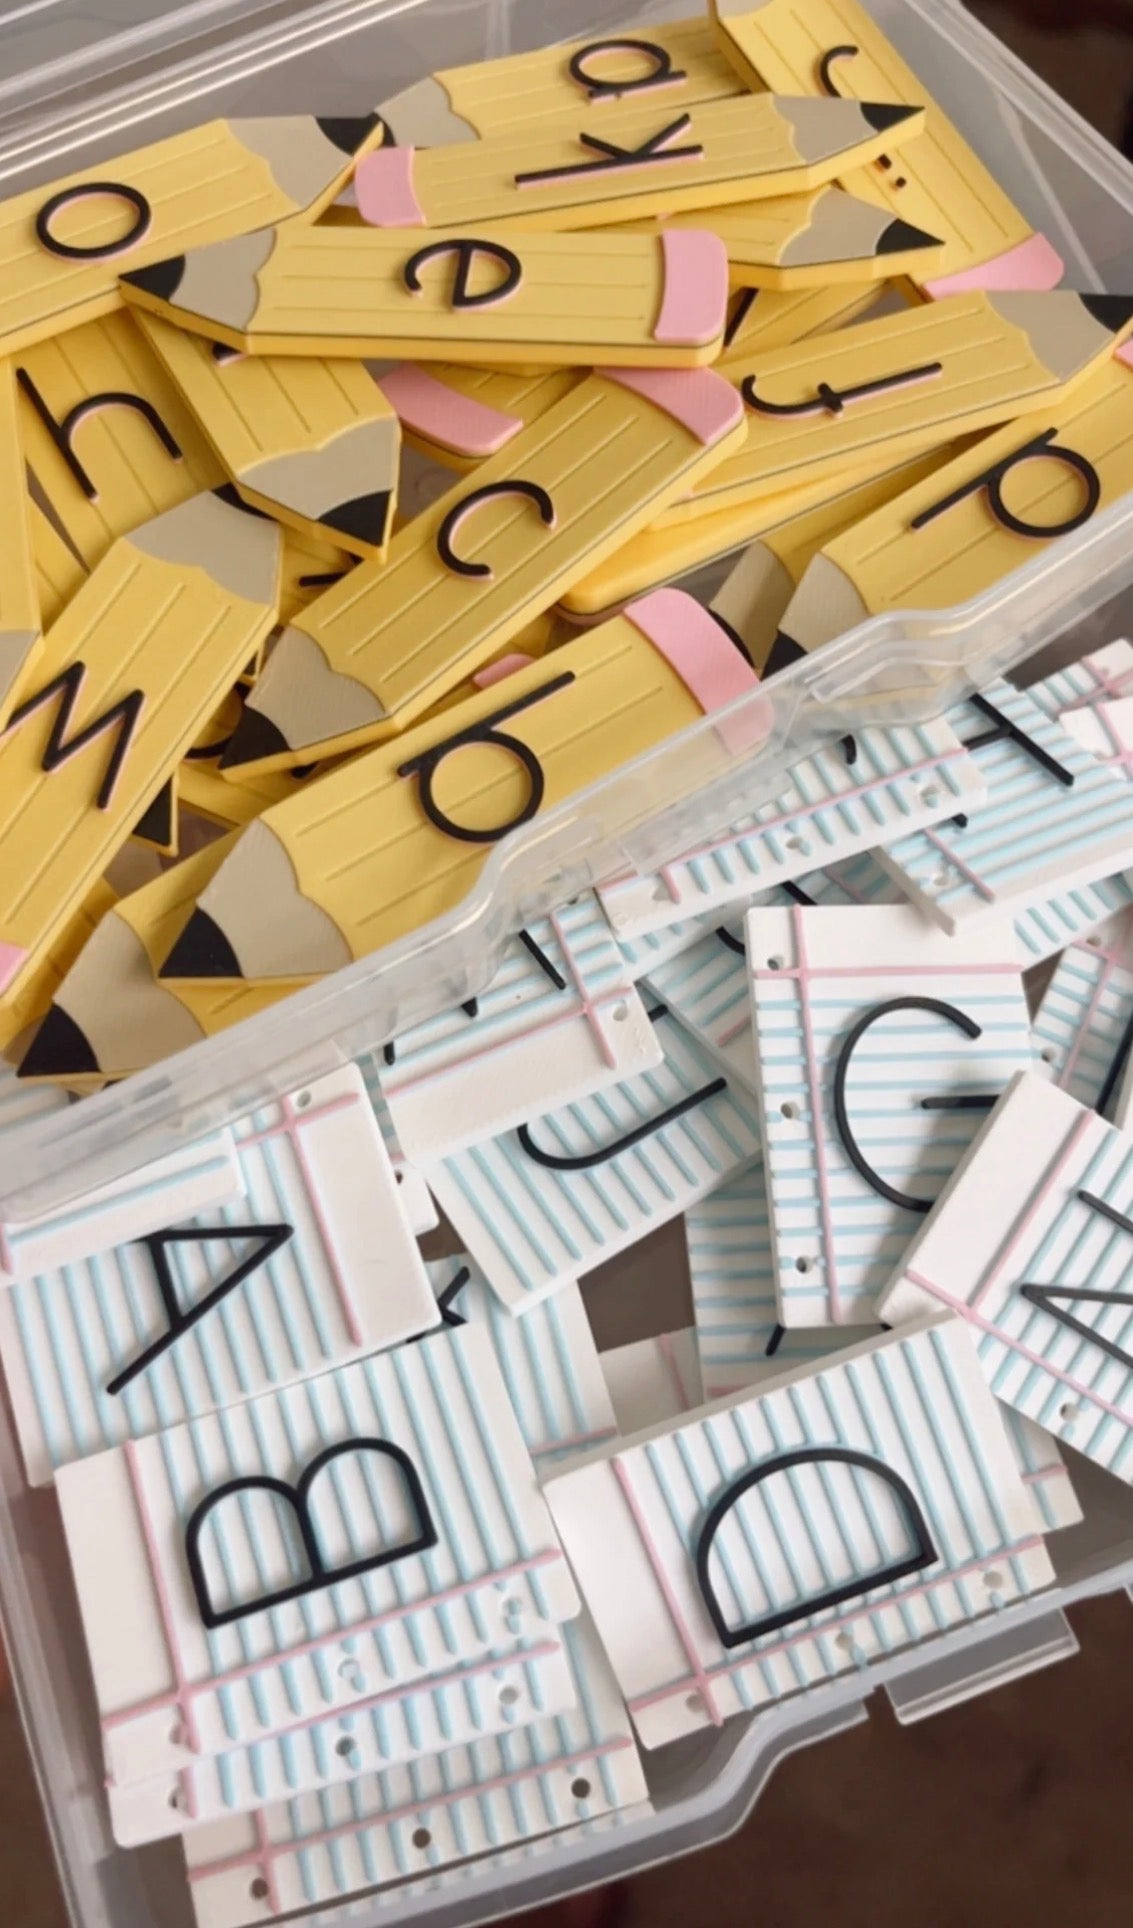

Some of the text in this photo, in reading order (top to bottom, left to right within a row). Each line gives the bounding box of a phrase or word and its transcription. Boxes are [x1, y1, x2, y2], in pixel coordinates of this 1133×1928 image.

[514, 112, 703, 184] k
[404, 239, 522, 307] e
[15, 367, 183, 500] h
[741, 362, 943, 415] f
[436, 479, 555, 578] c
[396, 670, 576, 844] b
[832, 995, 1000, 1213] G
[106, 1223, 294, 1395] A
[184, 1437, 438, 1630] B
[694, 1447, 939, 1649] D
